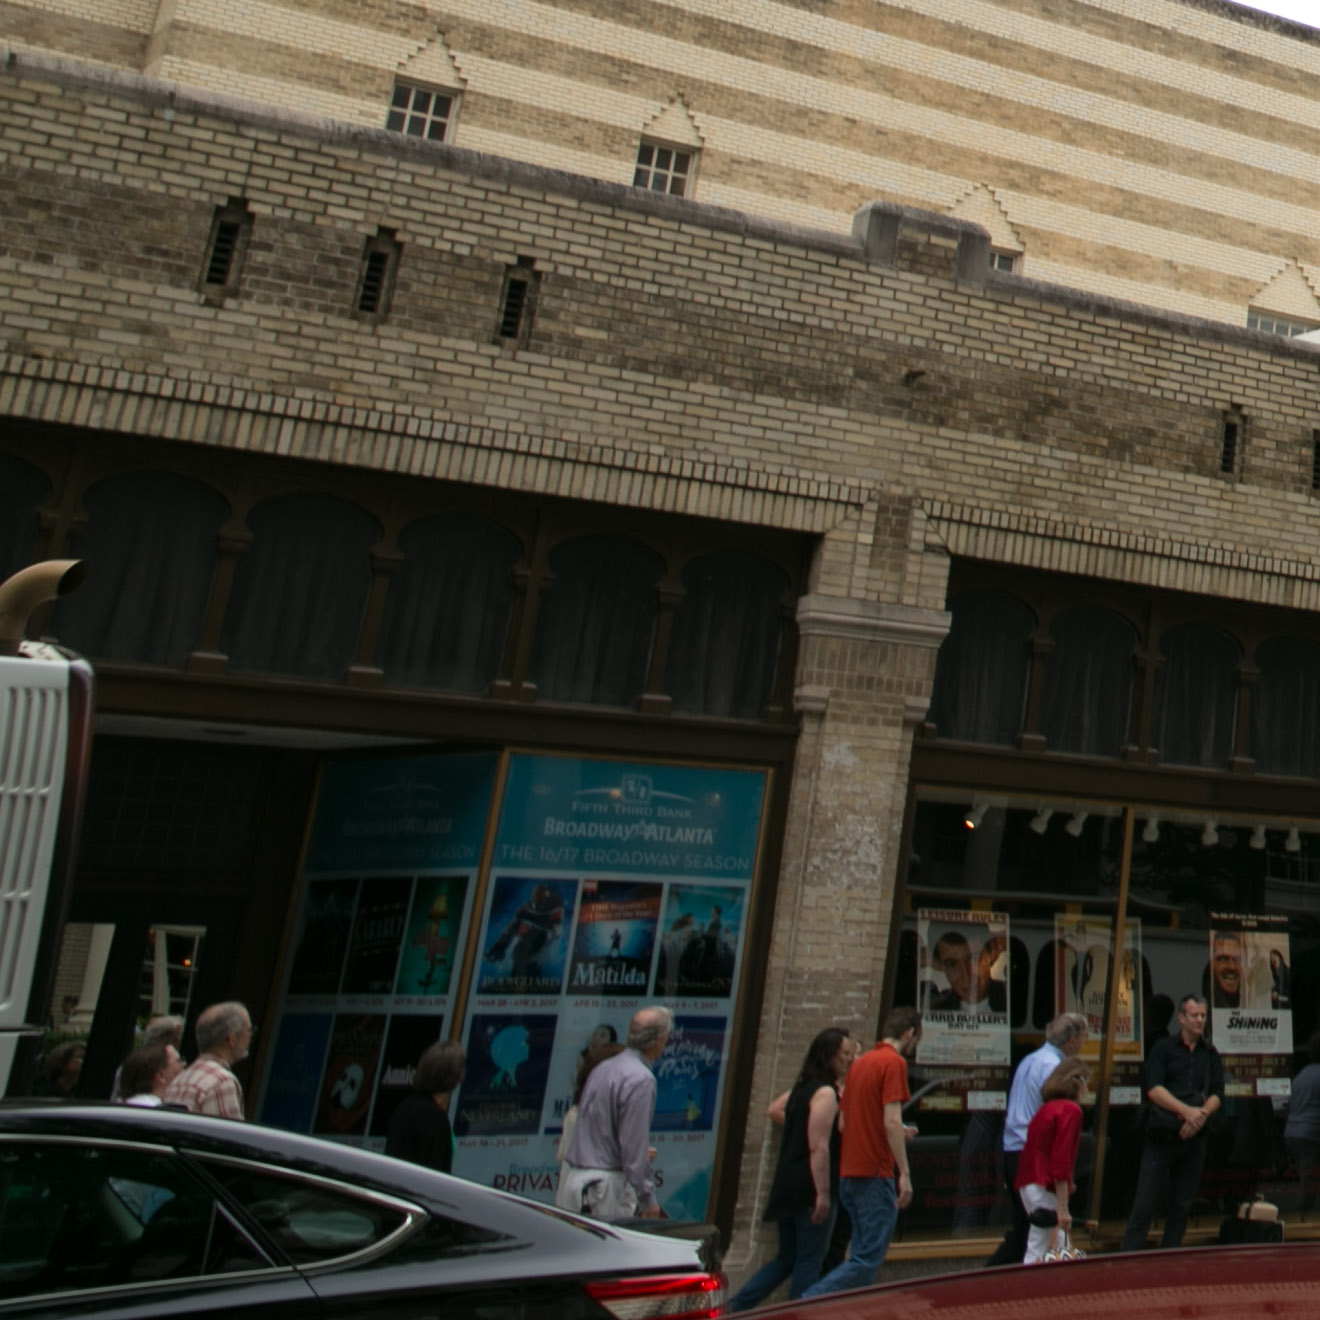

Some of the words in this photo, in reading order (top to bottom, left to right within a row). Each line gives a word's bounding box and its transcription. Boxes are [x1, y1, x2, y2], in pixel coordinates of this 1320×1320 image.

[572, 800, 608, 813] FIFTH
[614, 802, 653, 816] THIRD
[657, 805, 692, 819] BANK
[543, 817, 632, 843] BROADWAY
[643, 822, 713, 844] ATLANTA
[501, 843, 535, 861] THE
[539, 845, 580, 863] 16/17
[584, 848, 679, 868] BROADWAY
[683, 853, 749, 871] SEASON
[572, 962, 647, 987] Matilda
[493, 1172, 561, 1192] PRIVAT
